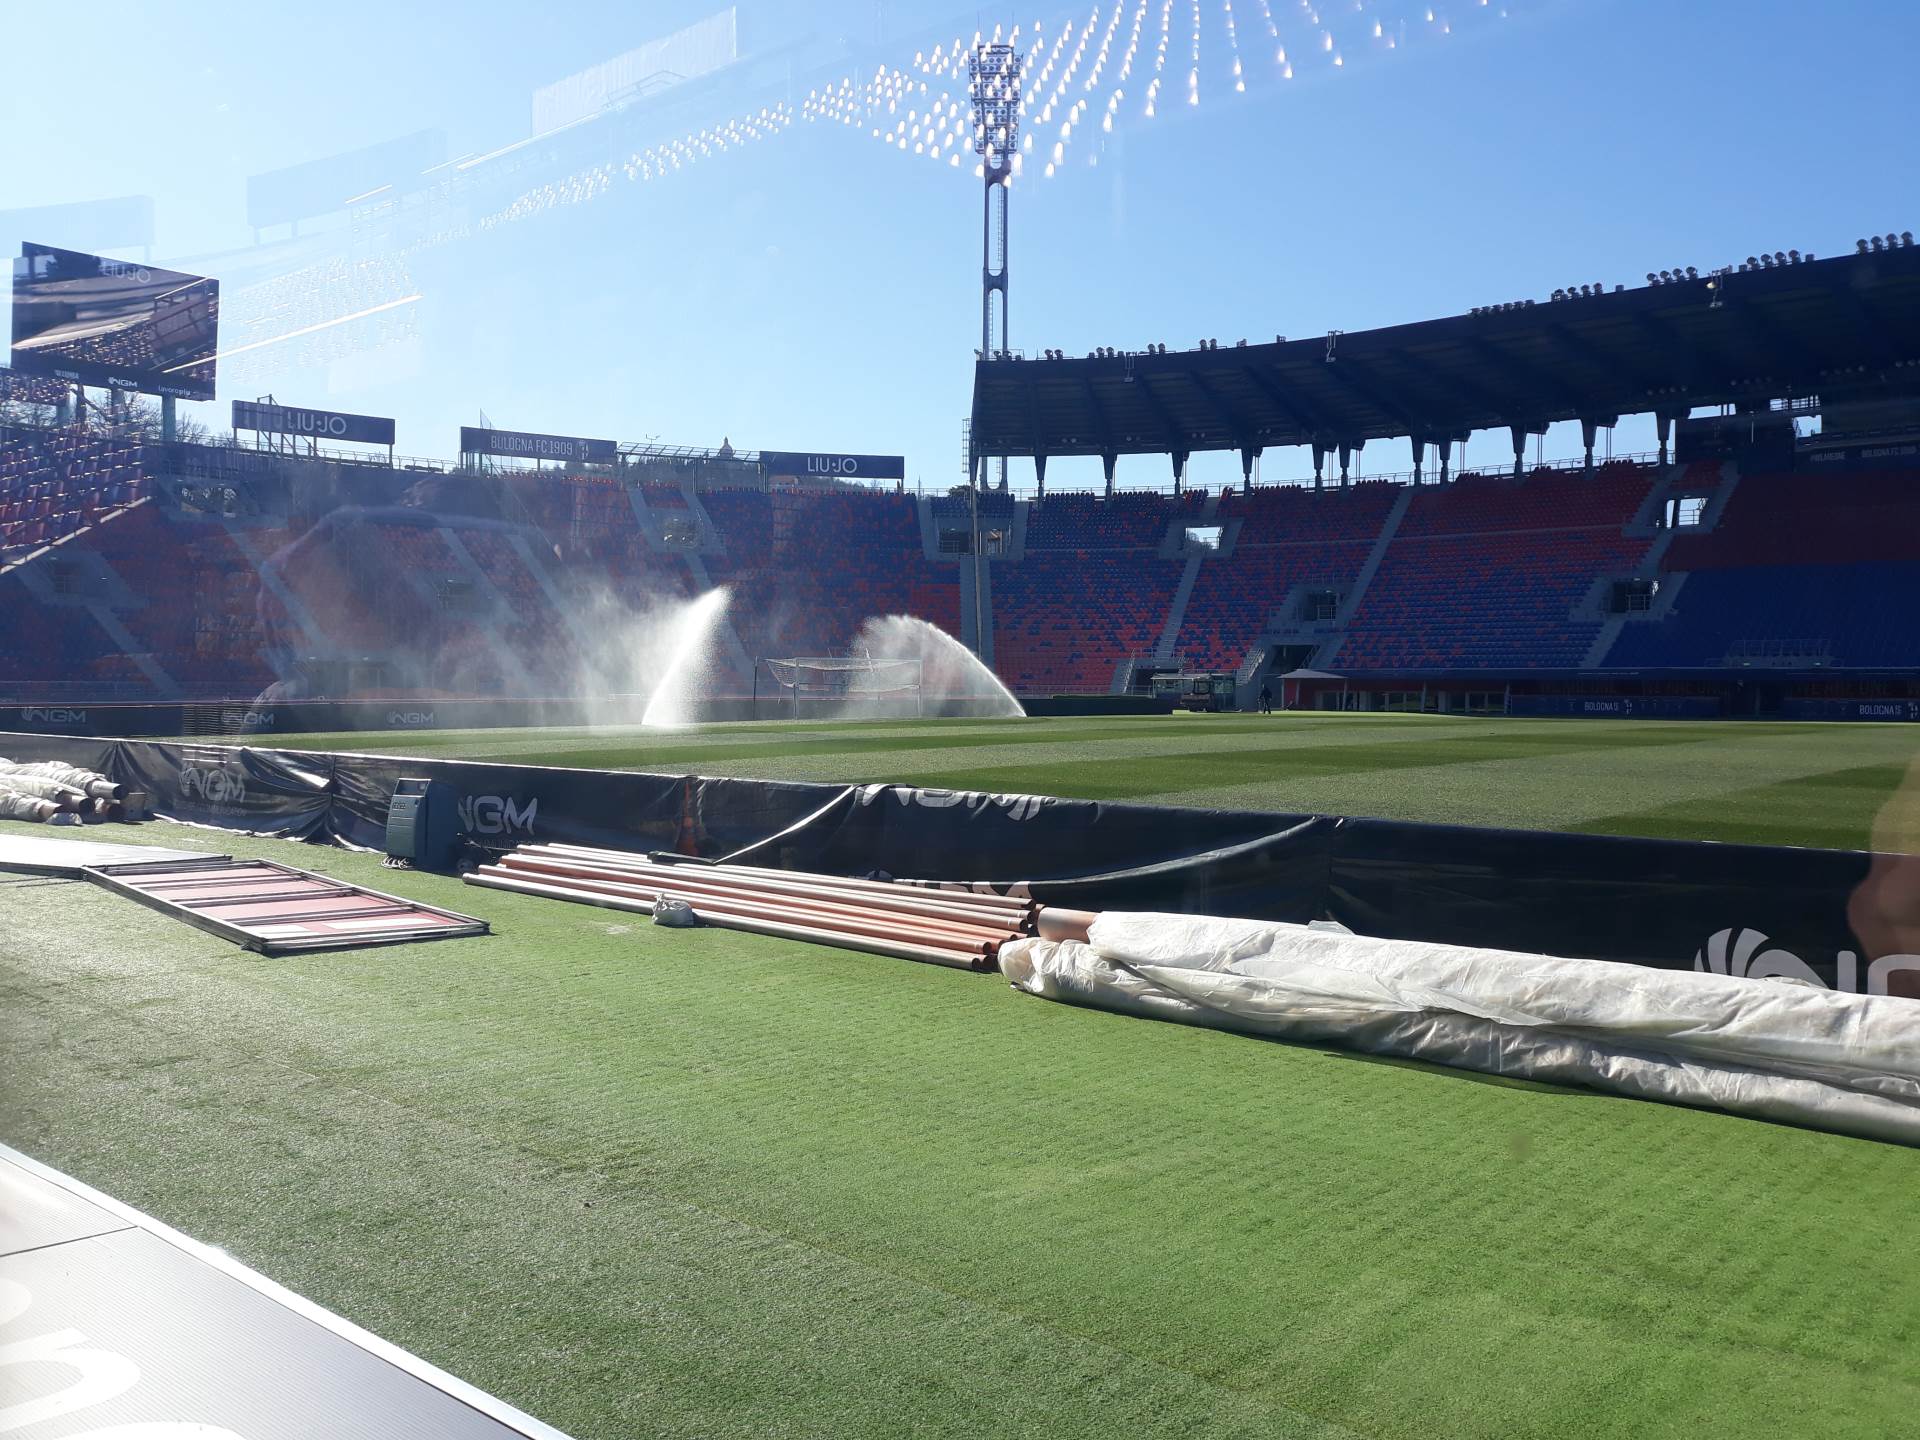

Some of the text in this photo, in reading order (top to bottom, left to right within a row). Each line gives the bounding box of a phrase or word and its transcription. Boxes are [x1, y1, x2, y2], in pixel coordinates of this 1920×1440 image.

[491, 435, 573, 456] BOLOGNA FC 1909
[24, 707, 86, 723] NGM
